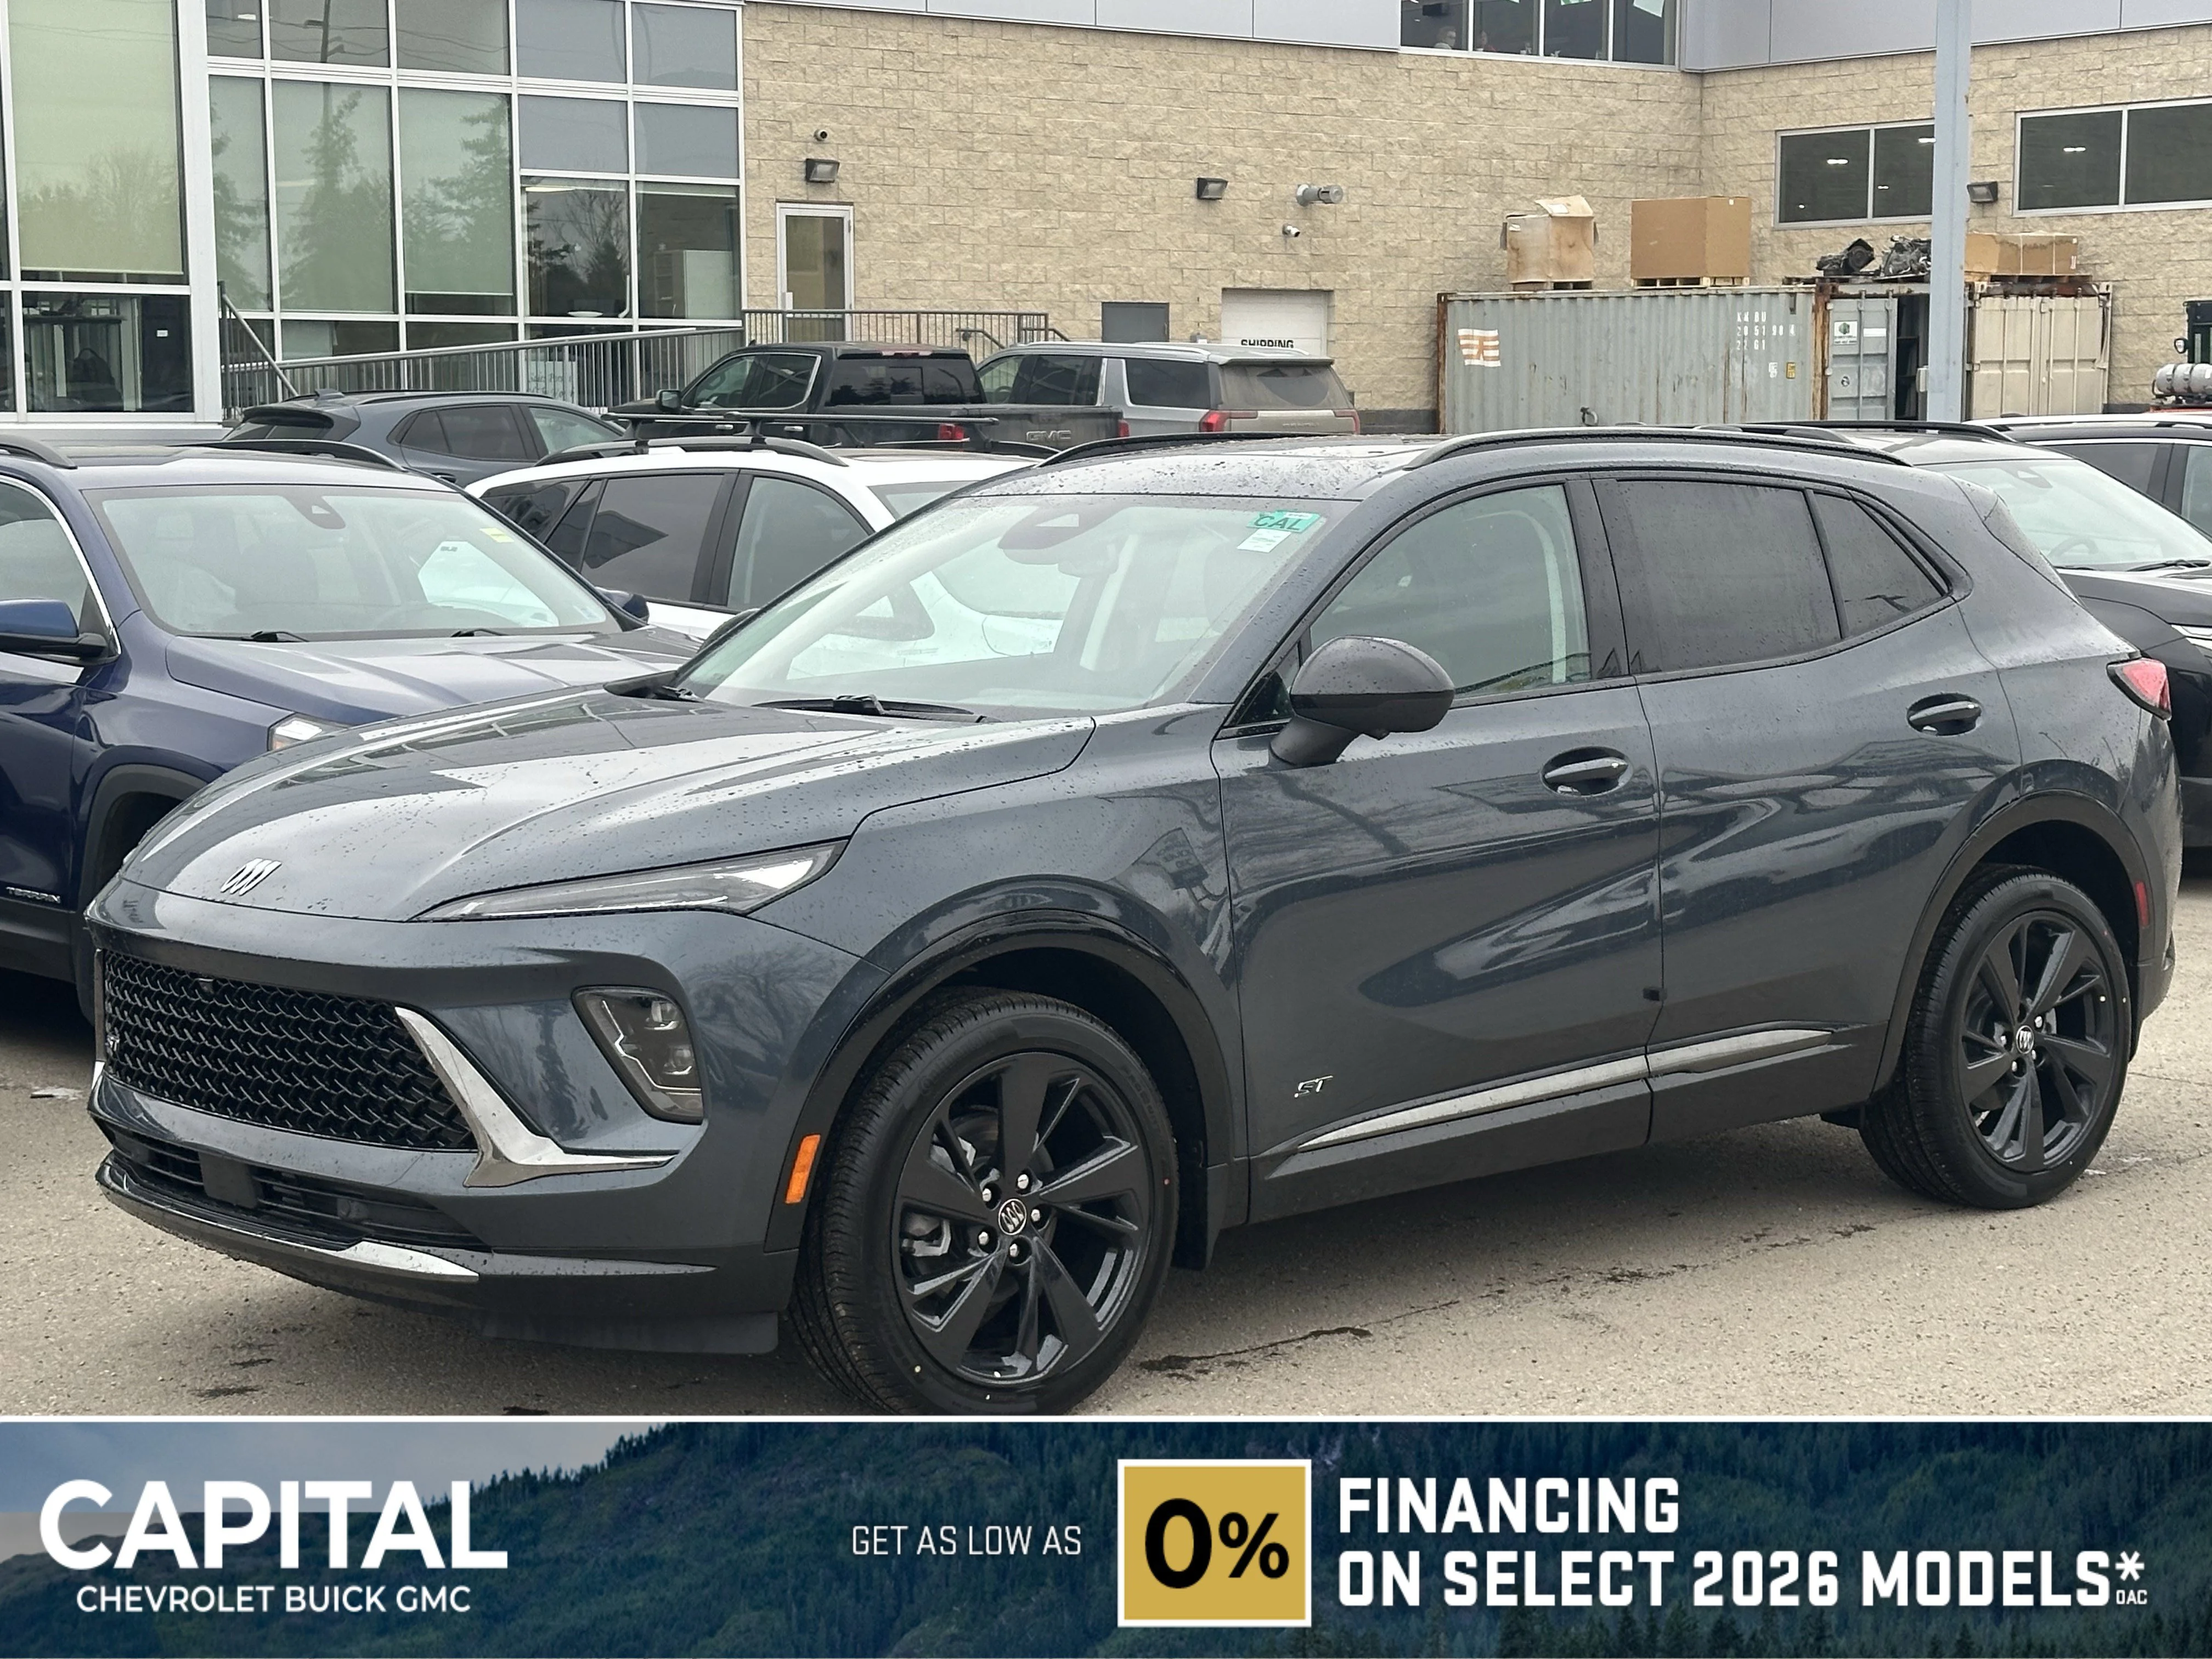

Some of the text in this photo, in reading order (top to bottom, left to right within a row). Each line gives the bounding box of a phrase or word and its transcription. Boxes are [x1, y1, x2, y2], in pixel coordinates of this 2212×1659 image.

[1026, 430, 1072, 442] GMC
[1254, 515, 1302, 531] CAL
[1294, 1075, 1334, 1098] ST
